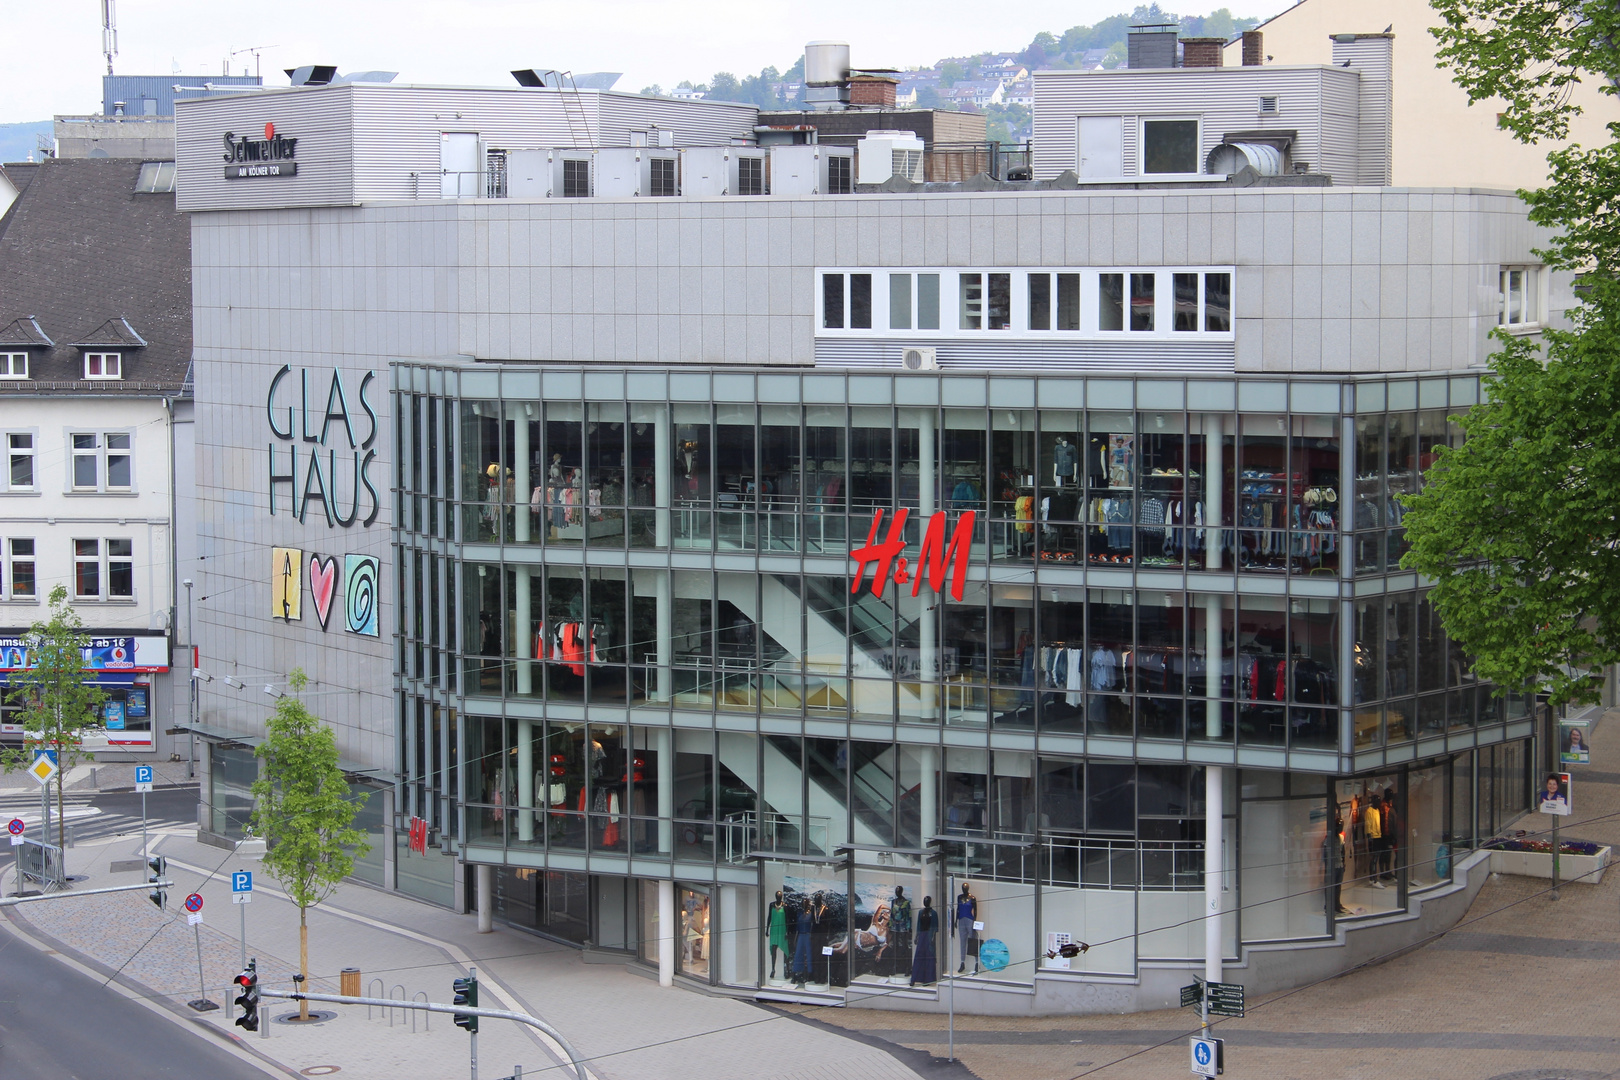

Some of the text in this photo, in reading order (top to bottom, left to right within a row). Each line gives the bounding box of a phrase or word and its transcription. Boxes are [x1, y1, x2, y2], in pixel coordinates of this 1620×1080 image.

[223, 122, 299, 163] Schneider
[239, 165, 279, 177] AM KÖLNER TOR
[267, 363, 378, 450] GLAS
[269, 443, 379, 528] HAUS
[850, 508, 976, 602] H&M
[96, 639, 109, 647] ab
[113, 638, 125, 647] 1€
[139, 768, 149, 781] P
[236, 874, 248, 890] P
[1196, 1064, 1210, 1074] ZONE
